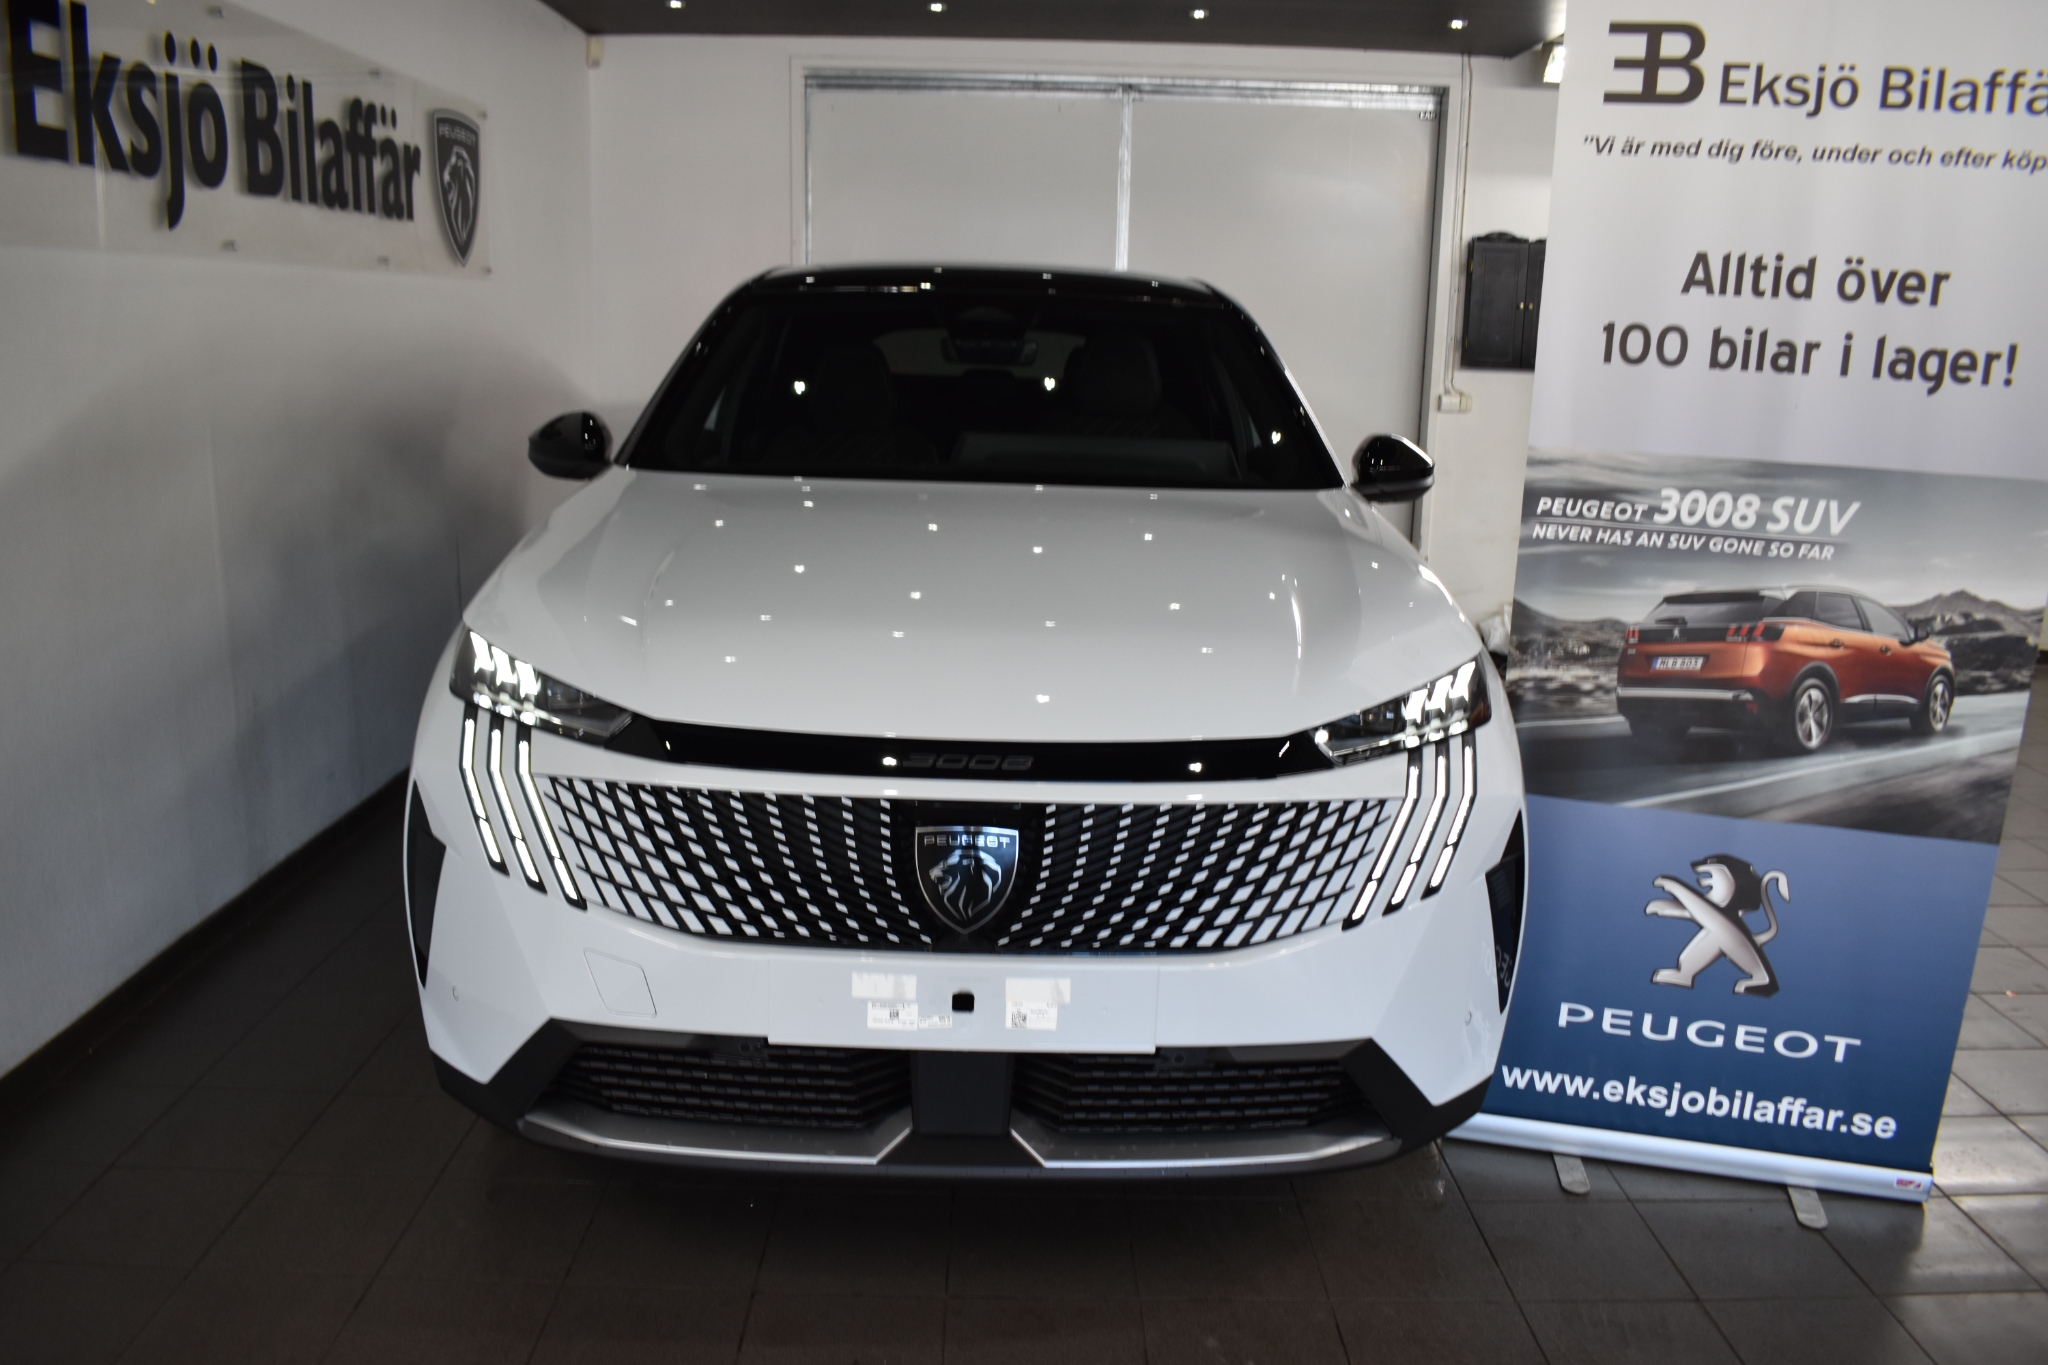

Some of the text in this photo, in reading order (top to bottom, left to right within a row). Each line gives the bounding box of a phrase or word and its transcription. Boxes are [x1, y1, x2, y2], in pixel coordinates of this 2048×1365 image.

[7, 0, 421, 230] Eksjö Bilaffär
[1719, 61, 2048, 119] Eksjö Bilaffä
[1620, 136, 1645, 157] är
[1649, 137, 1702, 159] med
[1706, 138, 1744, 164] dig
[1750, 138, 1803, 165] före,
[1811, 142, 1883, 164] under
[1887, 145, 1933, 166] och
[1939, 146, 1996, 168] efter
[2001, 148, 2048, 175] köp
[1680, 250, 1951, 308] Alltid över
[1602, 320, 2019, 396] 100 bilar i lager!
[1536, 486, 1861, 537] PEUGEOT 3008 SUV
[1532, 522, 1836, 561] NEVER HAS AN SUV GONE SO FAR
[902, 752, 1034, 771] 3008
[924, 834, 1011, 849] PEUGEOT
[1557, 1001, 1862, 1064] PEUGEOT
[1501, 1064, 1898, 1139] www.eksjobilaffar.se
